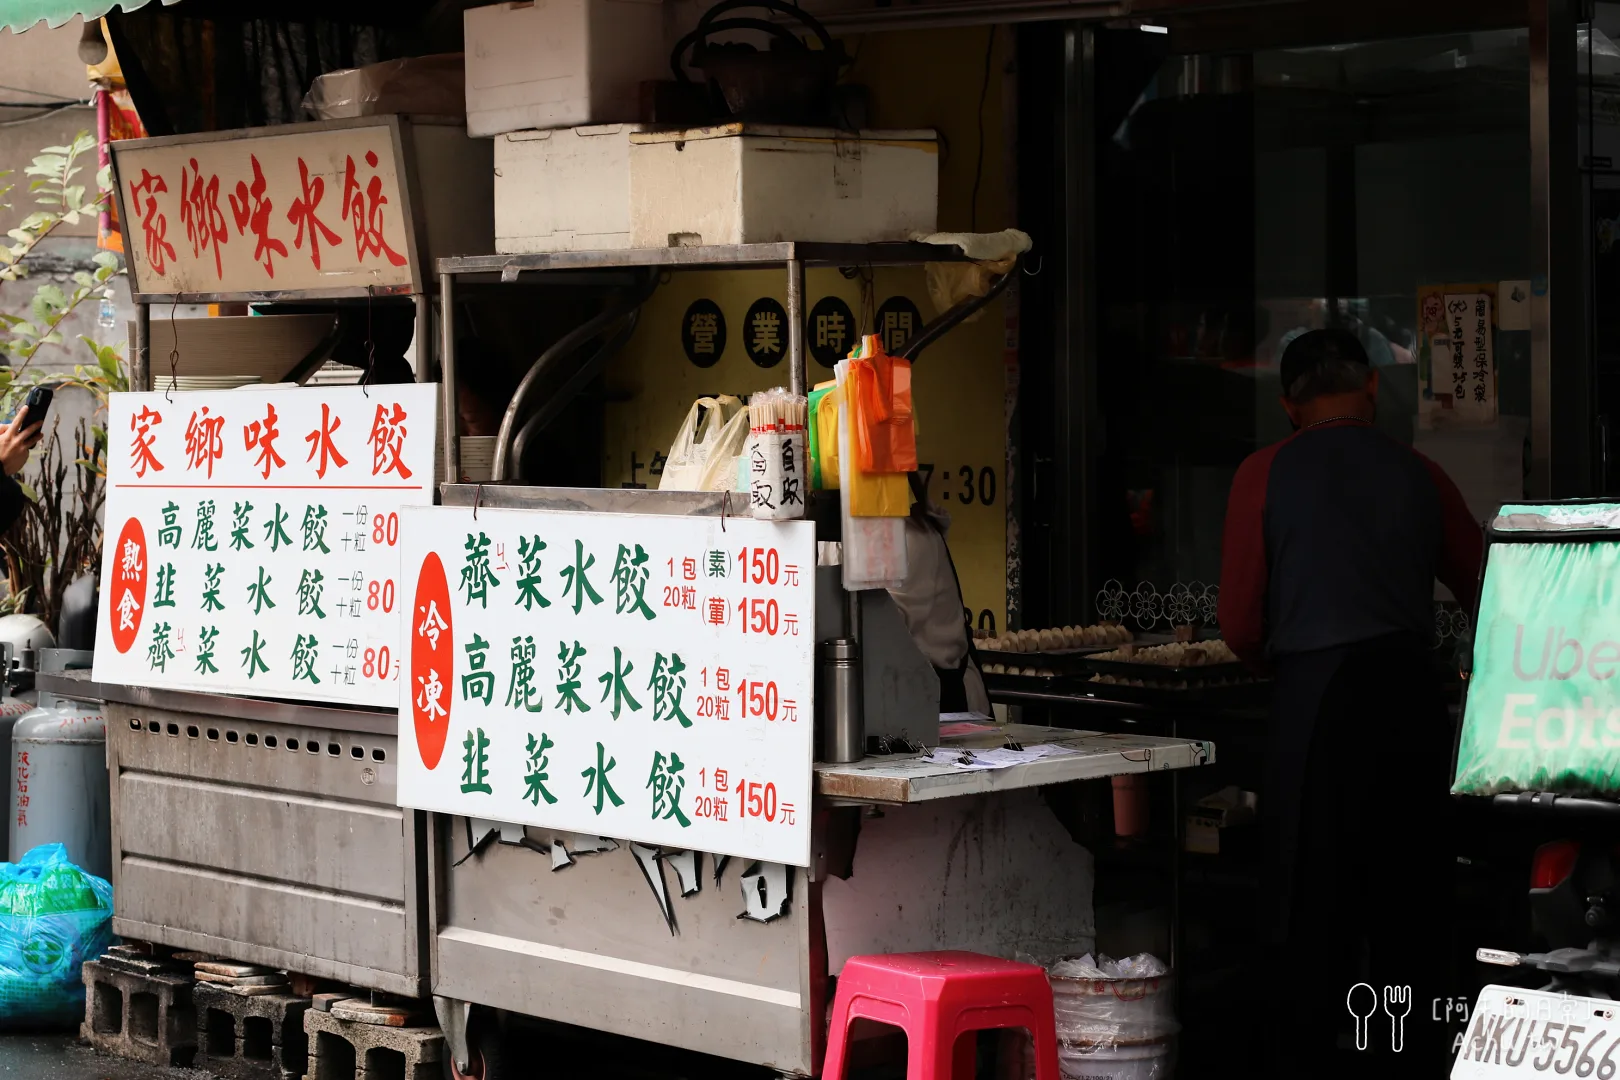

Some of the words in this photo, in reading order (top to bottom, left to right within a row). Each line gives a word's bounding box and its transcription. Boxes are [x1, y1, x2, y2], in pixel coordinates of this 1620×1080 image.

[130, 150, 407, 280] 家鄉味水餃
[689, 311, 913, 354] 營業時間
[130, 403, 412, 480] 家鄉味水餃
[780, 438, 803, 505] 自取
[157, 500, 331, 554] 高麗菜水餃
[342, 505, 368, 525] 一份
[372, 512, 399, 547] 80
[341, 531, 367, 552] 十粒
[116, 538, 144, 631] 熟食
[152, 562, 327, 619] 韭菜水餃
[337, 571, 364, 591] 一份
[367, 578, 395, 615] 80
[336, 597, 362, 618] 十粒
[459, 532, 657, 621] 薺菜水餃
[146, 621, 321, 684] 薺菜水餃
[332, 638, 359, 659] 一份
[330, 664, 357, 686] 十粒
[416, 598, 450, 722] 冷凍
[461, 633, 693, 728] 高麗菜水餃
[17, 751, 30, 828] 液化石油氣
[460, 726, 692, 828] 韭菜水餃
